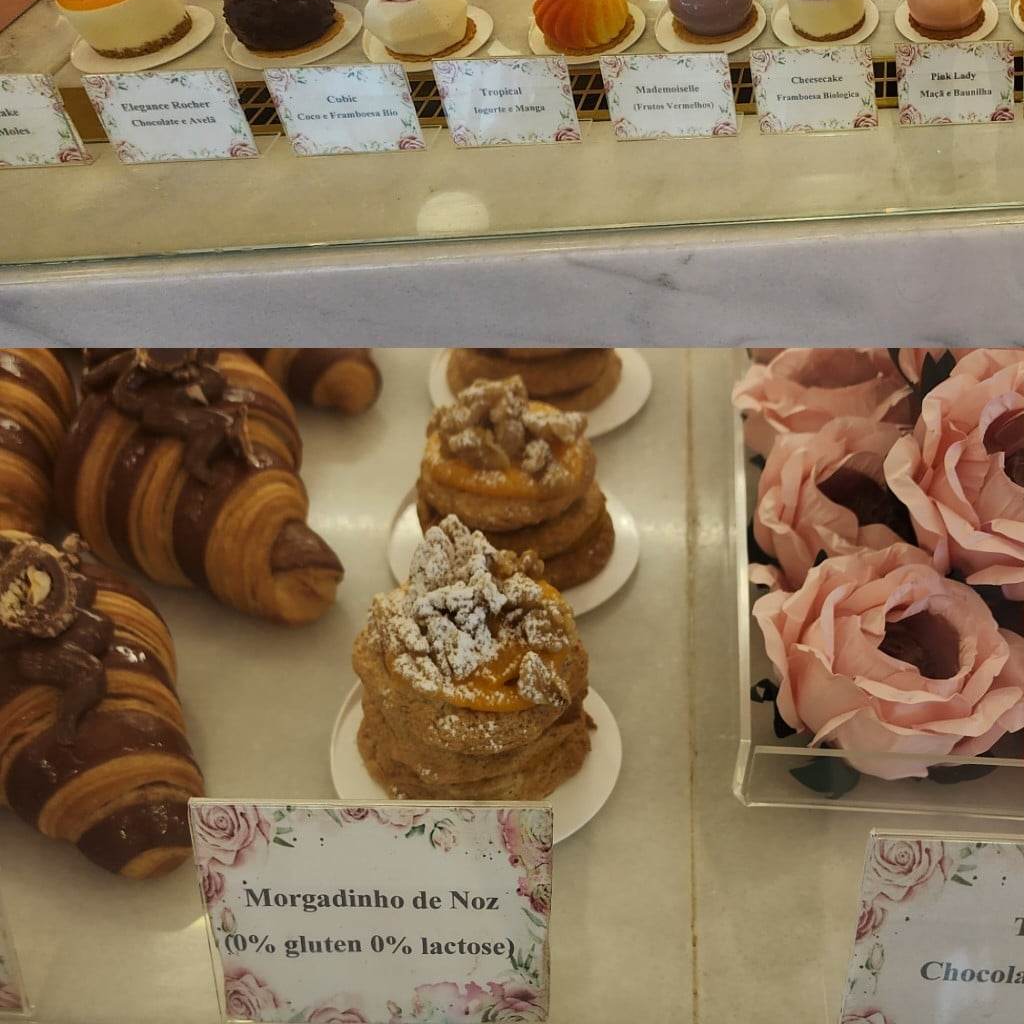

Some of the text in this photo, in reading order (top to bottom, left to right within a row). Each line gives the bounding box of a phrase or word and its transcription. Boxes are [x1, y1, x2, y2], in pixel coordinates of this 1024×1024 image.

[791, 75, 844, 85] Cheesecake
[931, 71, 977, 82] Pink Lady
[479, 86, 523, 98] Tropical
[635, 84, 700, 95] Mademoiselle
[919, 89, 945, 99] Maçã
[953, 87, 993, 97] Baunilha
[326, 94, 358, 105] Cubic
[776, 93, 822, 102] Framboesa
[121, 99, 211, 115] Elegance Rocher
[474, 104, 507, 116] Iogurte
[515, 103, 546, 115] Manga
[633, 100, 714, 112] (Frutos Vermelhos)
[297, 111, 321, 121] Coco
[330, 109, 381, 120] Framboesa
[383, 108, 398, 118] Bio
[131, 117, 180, 127] Chocolate
[189, 115, 217, 125] Avelã
[245, 888, 499, 913] Morgadinho de Noz
[224, 933, 515, 959] (0% gluten 0% lactose)
